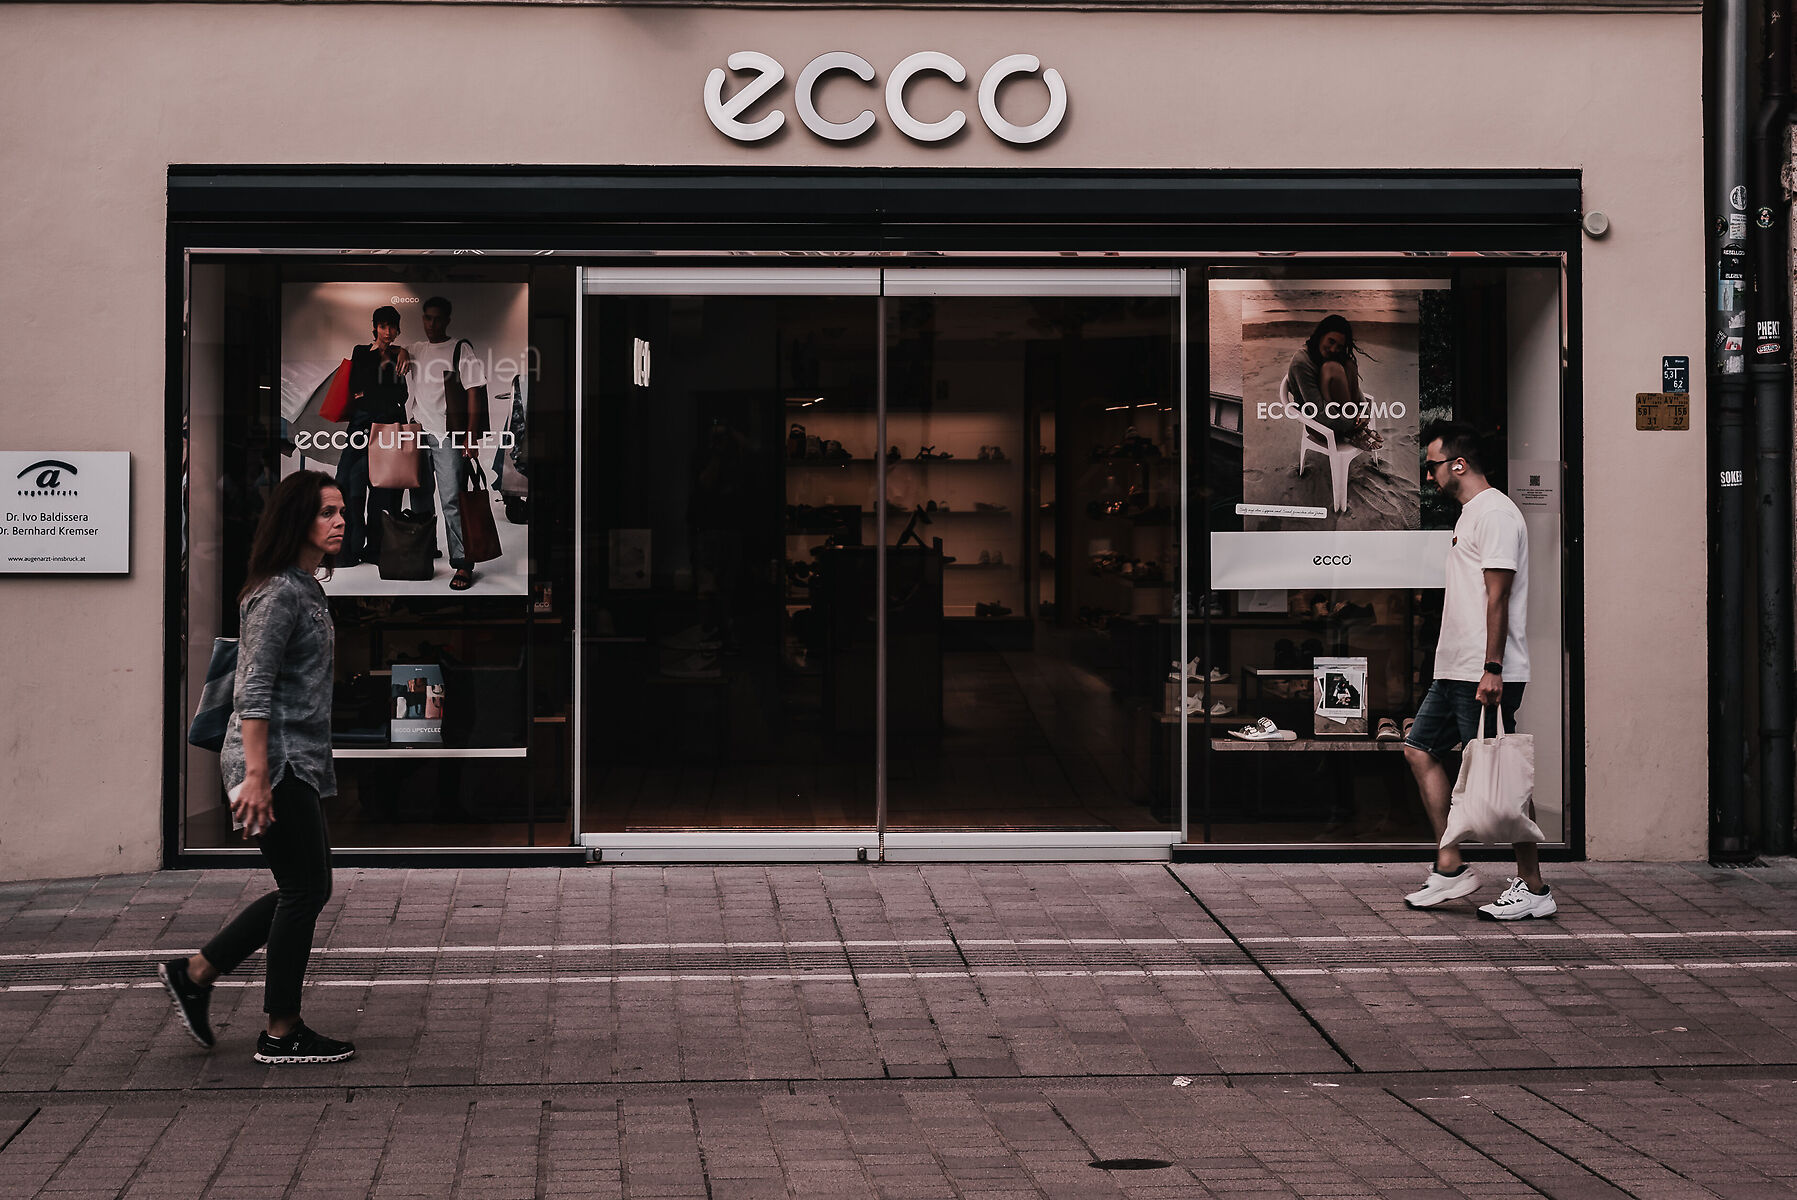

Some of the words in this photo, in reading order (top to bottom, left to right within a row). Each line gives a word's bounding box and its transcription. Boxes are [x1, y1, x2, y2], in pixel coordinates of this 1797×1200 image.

[704, 51, 1067, 143] ecco
[390, 295, 420, 305] @ecco
[1664, 371, 1674, 380] 5,3
[1673, 380, 1683, 389] 6,2
[1256, 401, 1318, 420] ECCO
[1324, 401, 1406, 420] COZMO
[377, 430, 516, 450] UPCYCLED
[6, 512, 19, 522] Dr.
[22, 512, 37, 522] Ivo
[40, 512, 89, 522] Baldissera
[12, 526, 56, 536] Bernhard
[58, 526, 99, 536] Kremser
[1312, 553, 1352, 567] ecco
